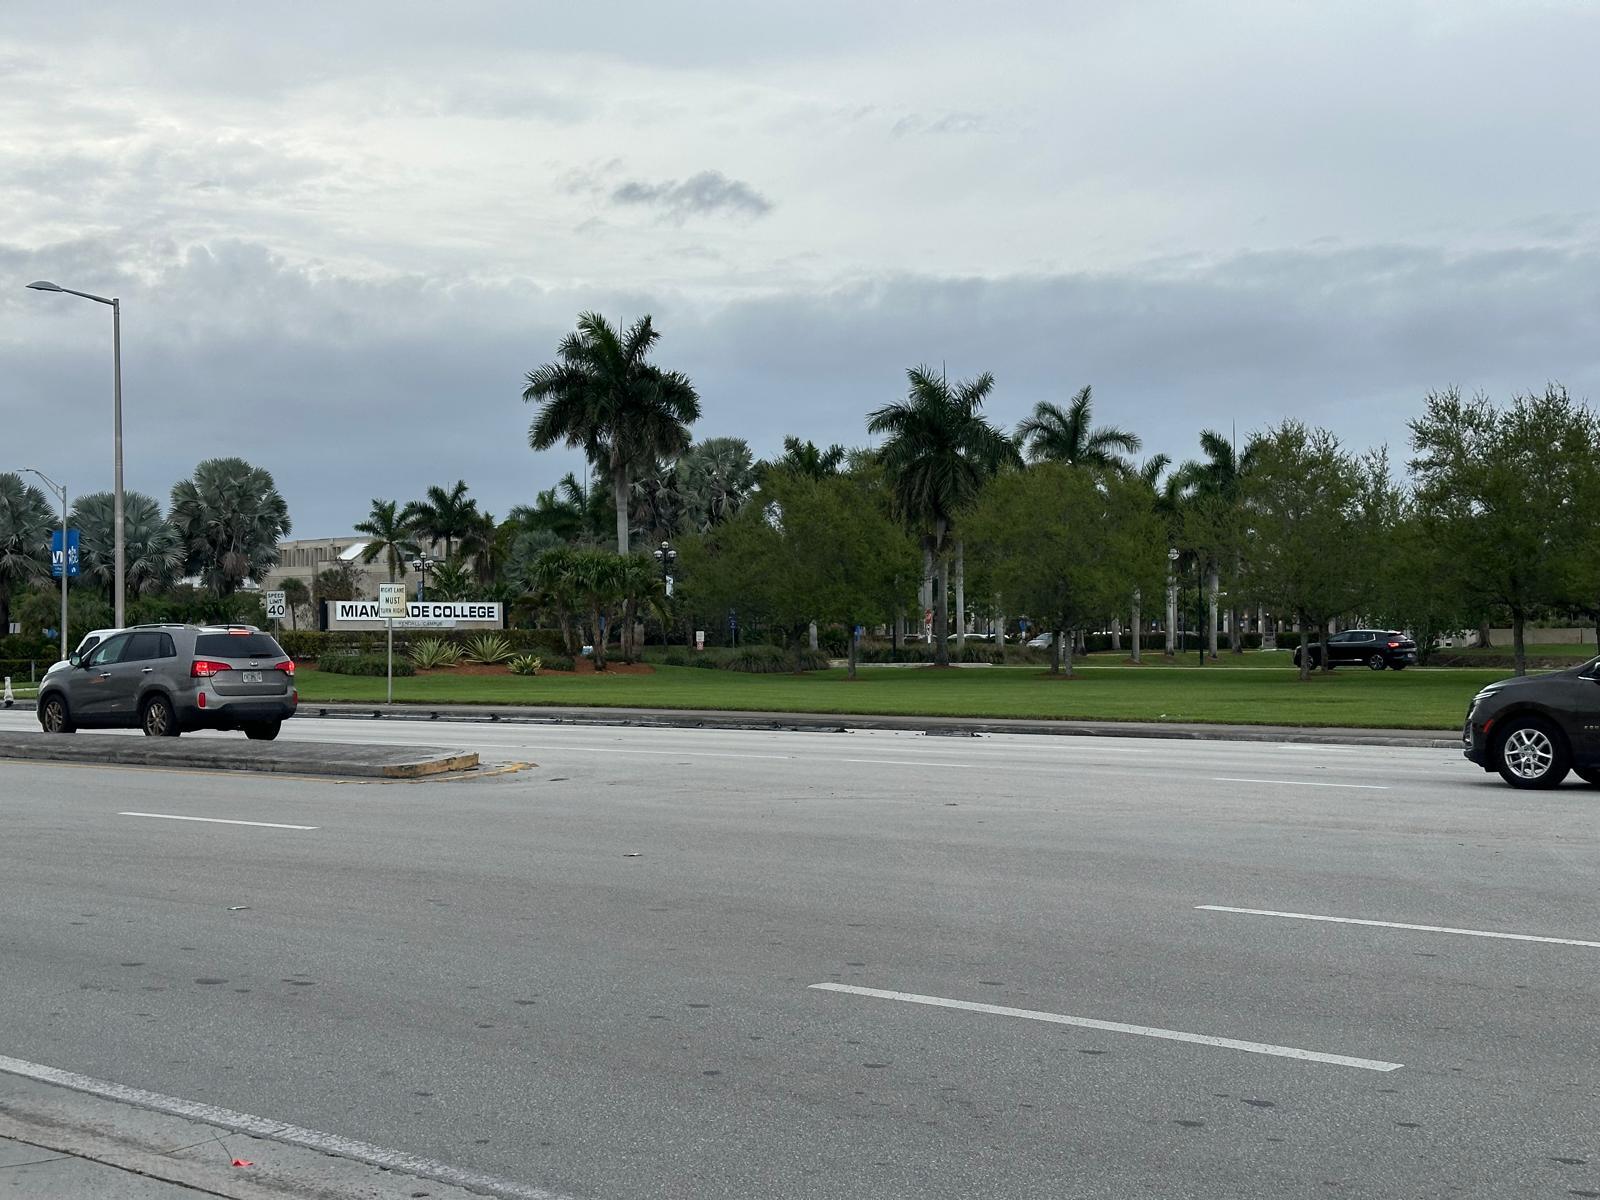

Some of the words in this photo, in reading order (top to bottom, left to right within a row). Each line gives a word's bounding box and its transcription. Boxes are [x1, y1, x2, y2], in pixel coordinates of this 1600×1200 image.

[268, 605, 285, 615] 40
[341, 605, 379, 617] MIAM
[433, 606, 495, 618] COLLEGE
